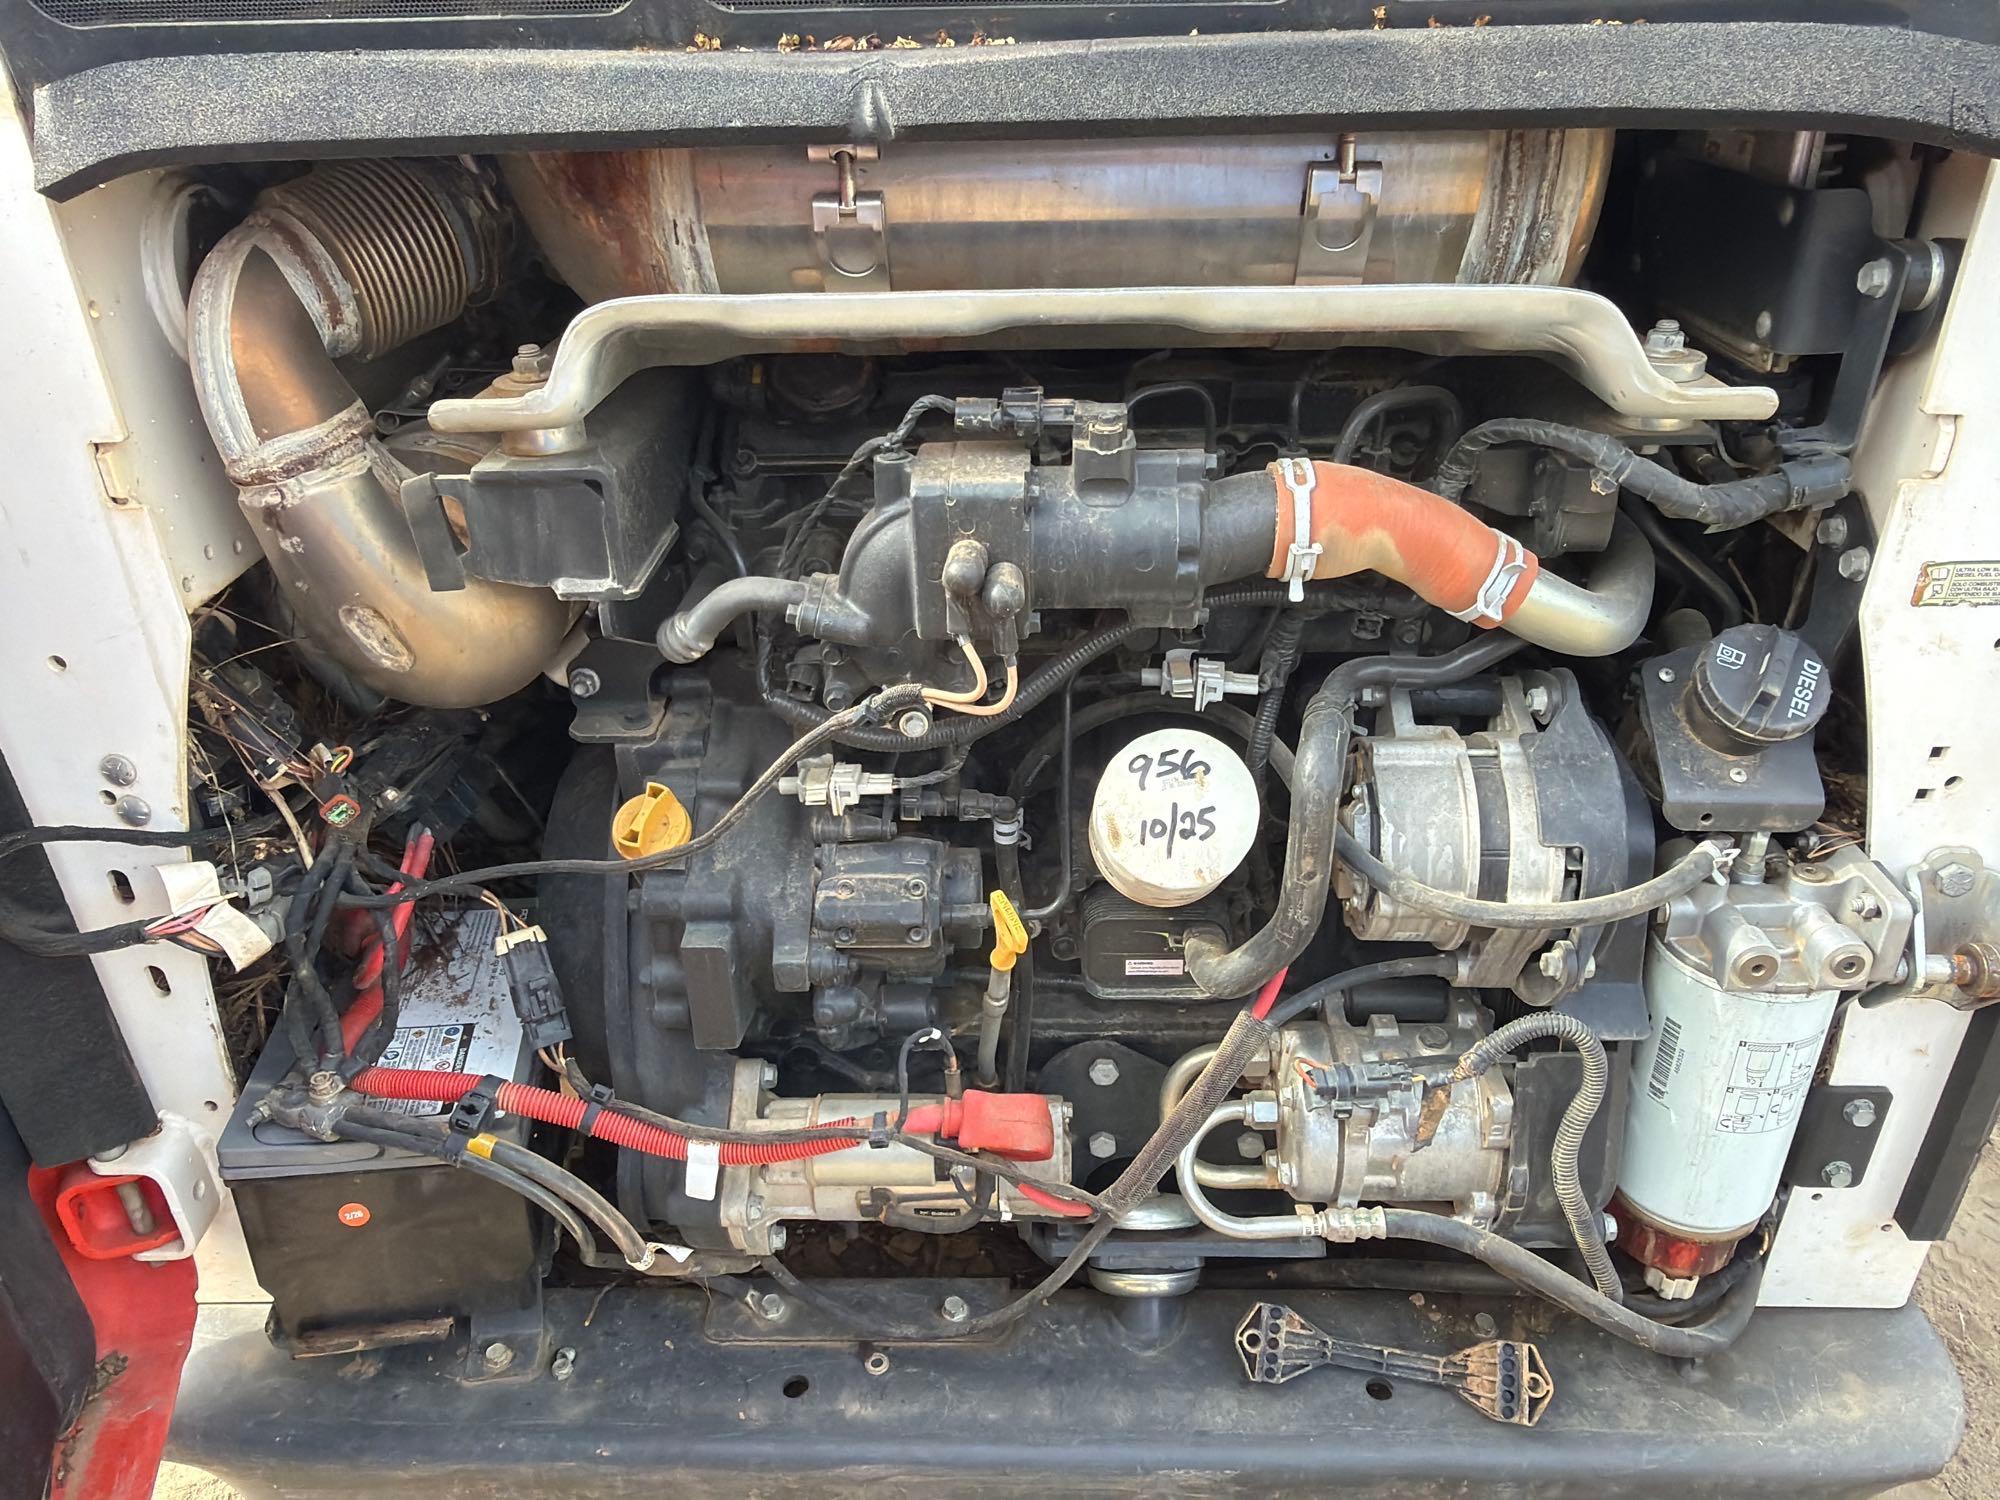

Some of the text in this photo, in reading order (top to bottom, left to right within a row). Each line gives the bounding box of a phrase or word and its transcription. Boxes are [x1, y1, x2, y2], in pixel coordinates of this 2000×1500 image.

[1787, 659, 1822, 719] DIESEL
[1128, 749, 1211, 791] 956
[1140, 802, 1216, 859] 10/25
